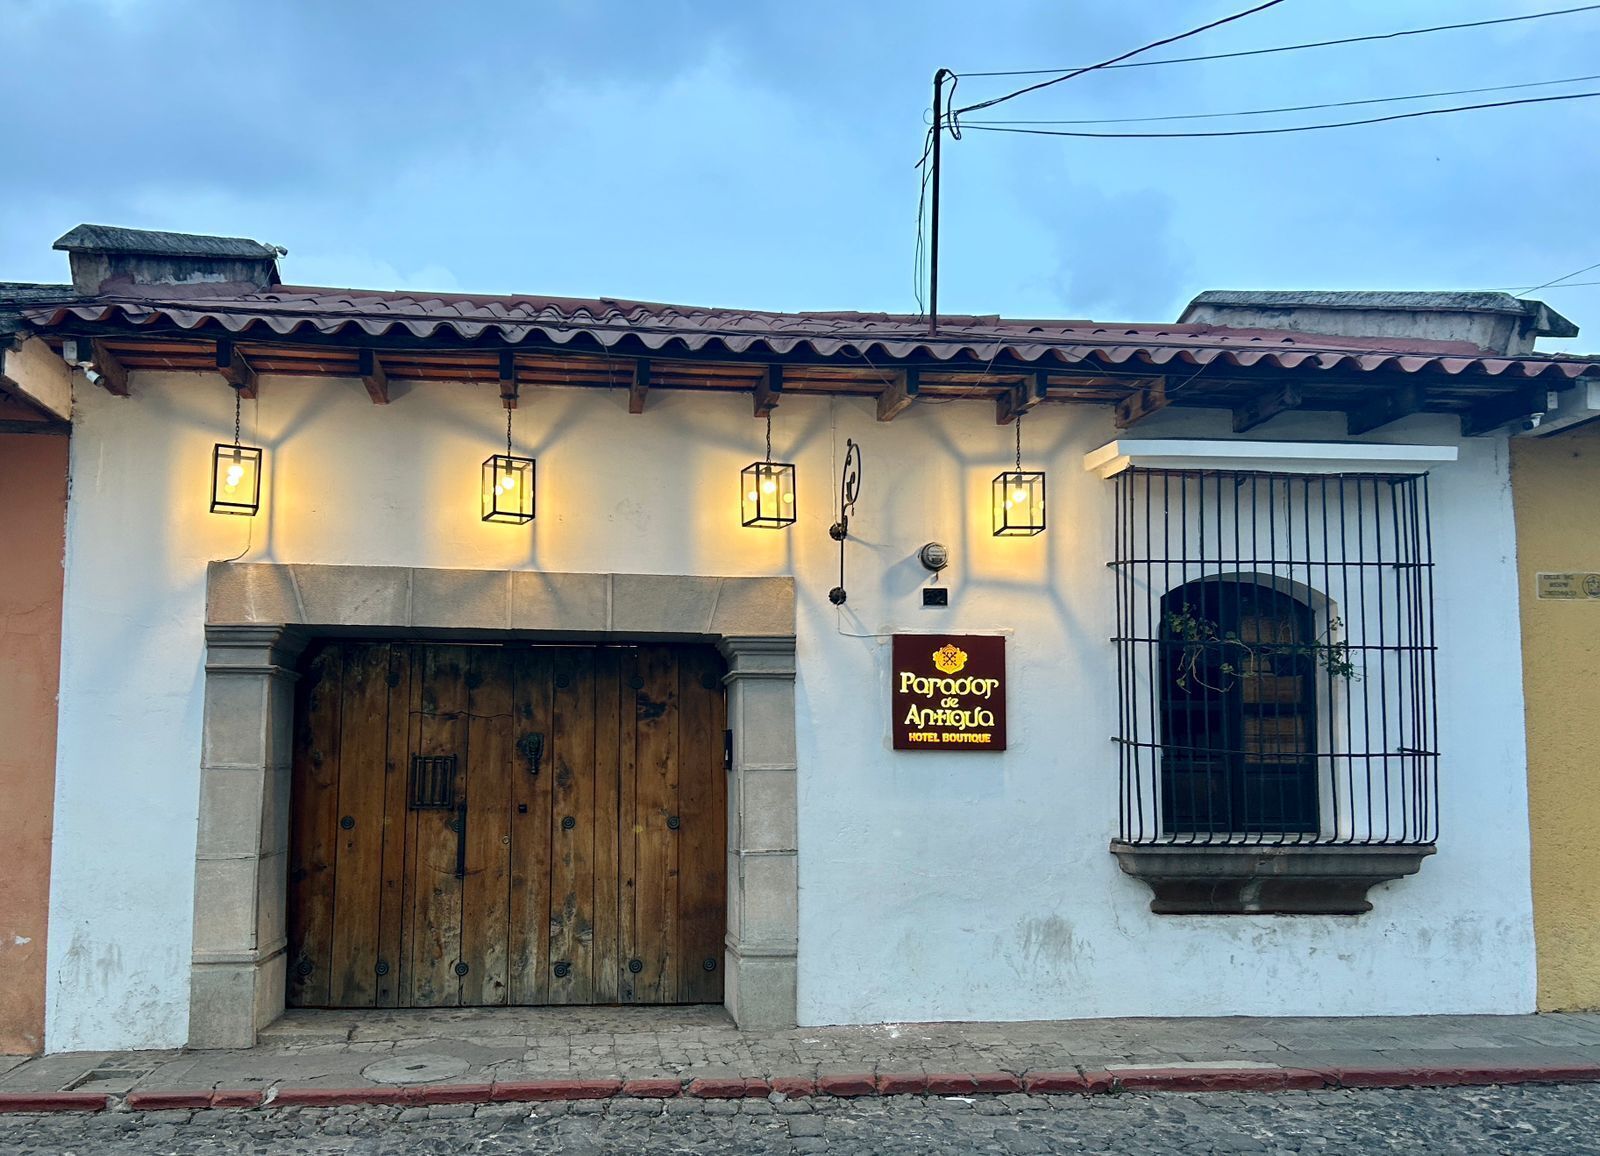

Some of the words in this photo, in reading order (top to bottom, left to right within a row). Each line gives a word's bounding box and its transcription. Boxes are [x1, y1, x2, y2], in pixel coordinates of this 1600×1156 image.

[899, 671, 1000, 699] Parador
[941, 697, 959, 708] de
[904, 703, 995, 731] Antigua
[908, 732, 940, 742] HOTEL
[942, 732, 991, 743] BOUTIQUE
